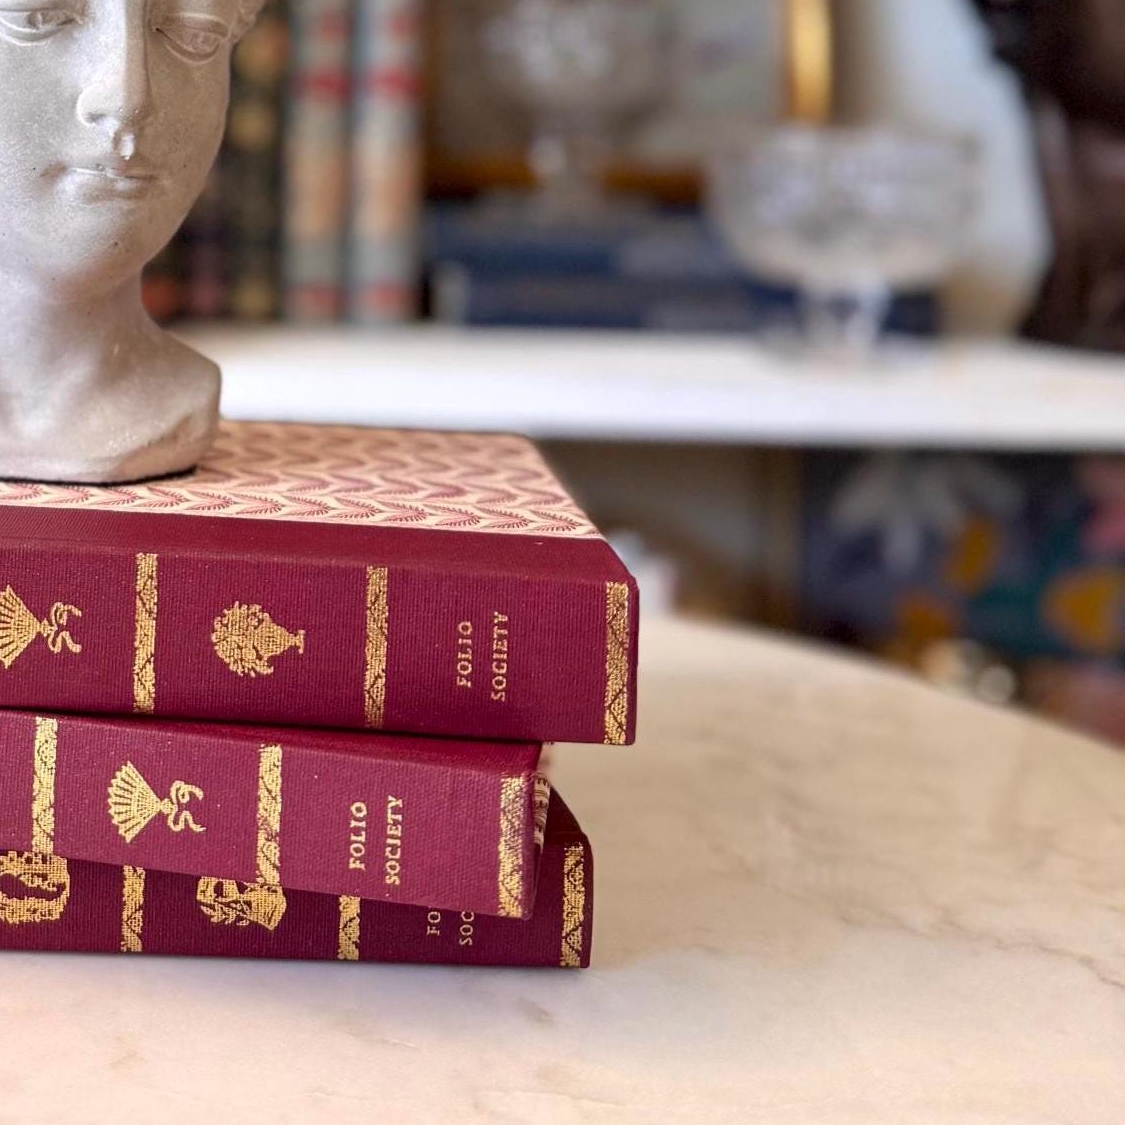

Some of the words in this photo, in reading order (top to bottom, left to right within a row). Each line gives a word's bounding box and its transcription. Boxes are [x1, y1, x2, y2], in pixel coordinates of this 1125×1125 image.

[456, 621, 473, 688] FOLIO
[490, 611, 509, 702] SOCIETY
[348, 801, 368, 871] FOLIO
[385, 795, 403, 885] SOCIETY
